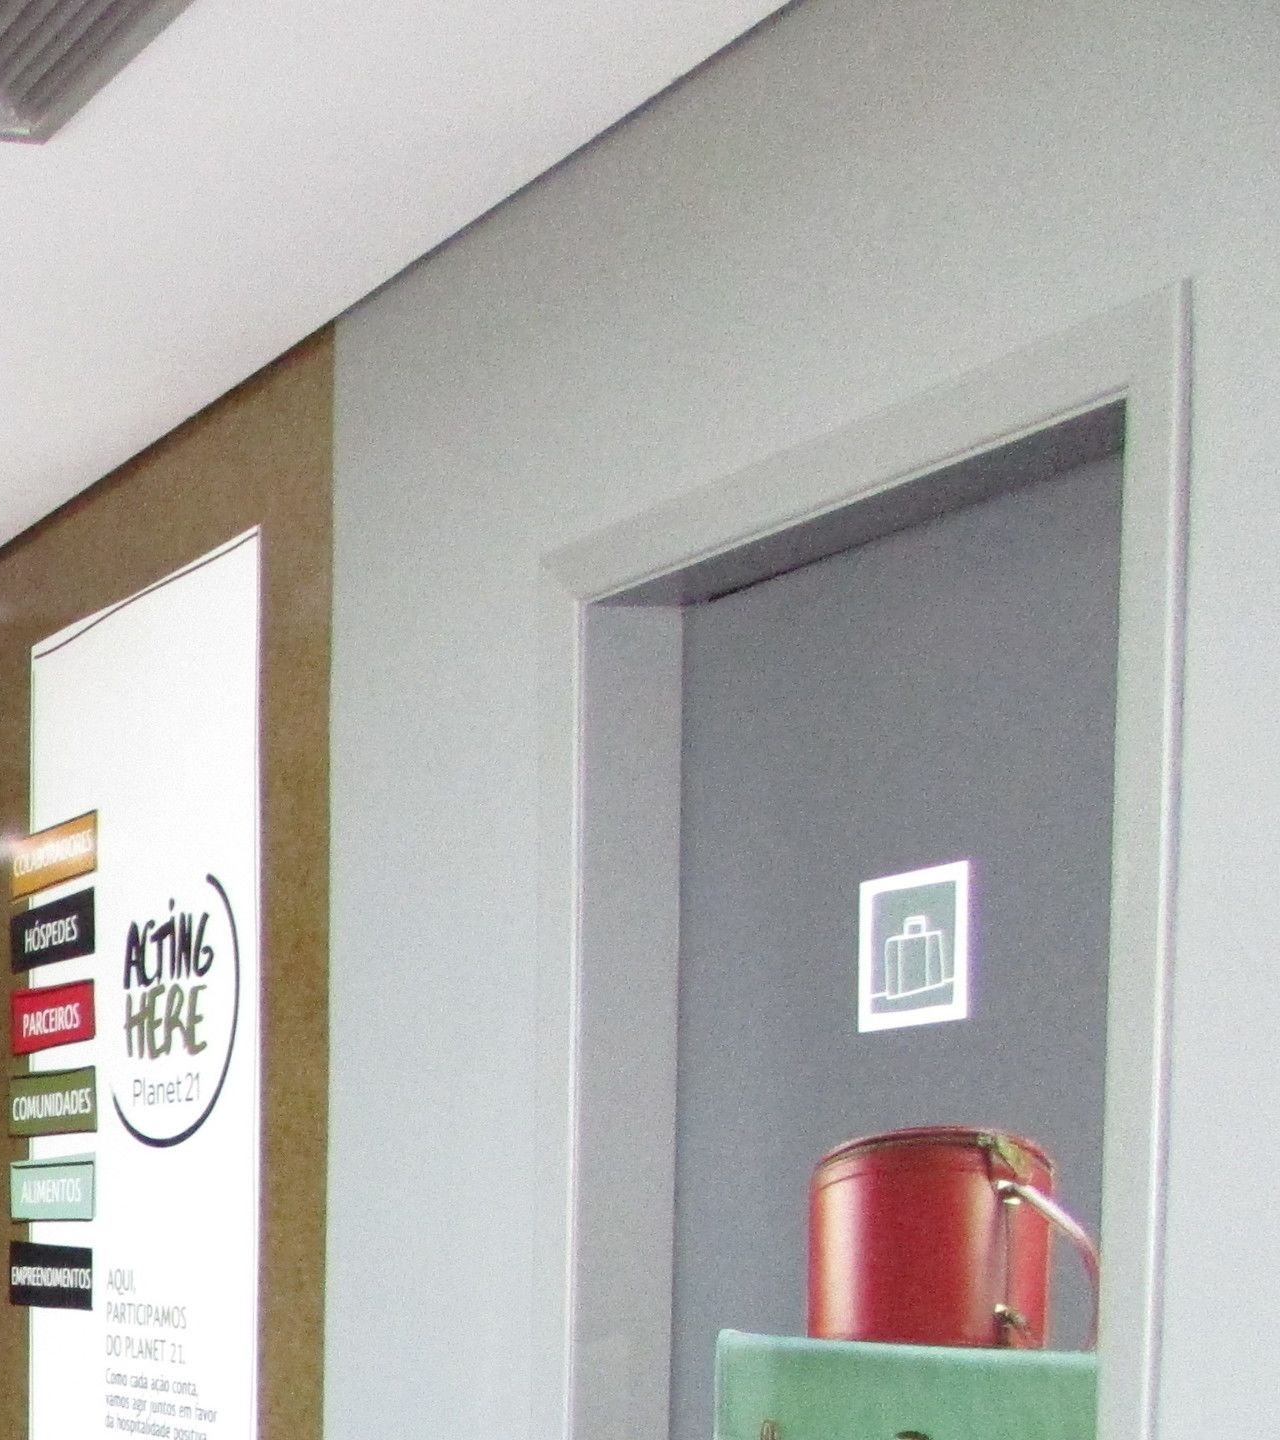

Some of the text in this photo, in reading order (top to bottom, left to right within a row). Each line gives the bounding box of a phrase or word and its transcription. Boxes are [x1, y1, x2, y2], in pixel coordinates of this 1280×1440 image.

[24, 914, 79, 953] HÓSPEDES
[22, 1002, 80, 1037] PARCEIROS
[123, 983, 208, 1060] HERE
[132, 1072, 200, 1107] Planet 21
[12, 1087, 92, 1121] COMUNIDADES
[20, 1177, 81, 1204] ALIMENTOS
[11, 1266, 91, 1290] EMPREENDIMENTOS
[106, 1268, 136, 1295] AQUI,
[106, 1301, 187, 1329] PARTICIPAMOS
[106, 1334, 122, 1356] DO
[125, 1336, 166, 1361] PLANET
[105, 1368, 127, 1386] Como
[130, 1371, 148, 1389] cada
[179, 1406, 192, 1419] em
